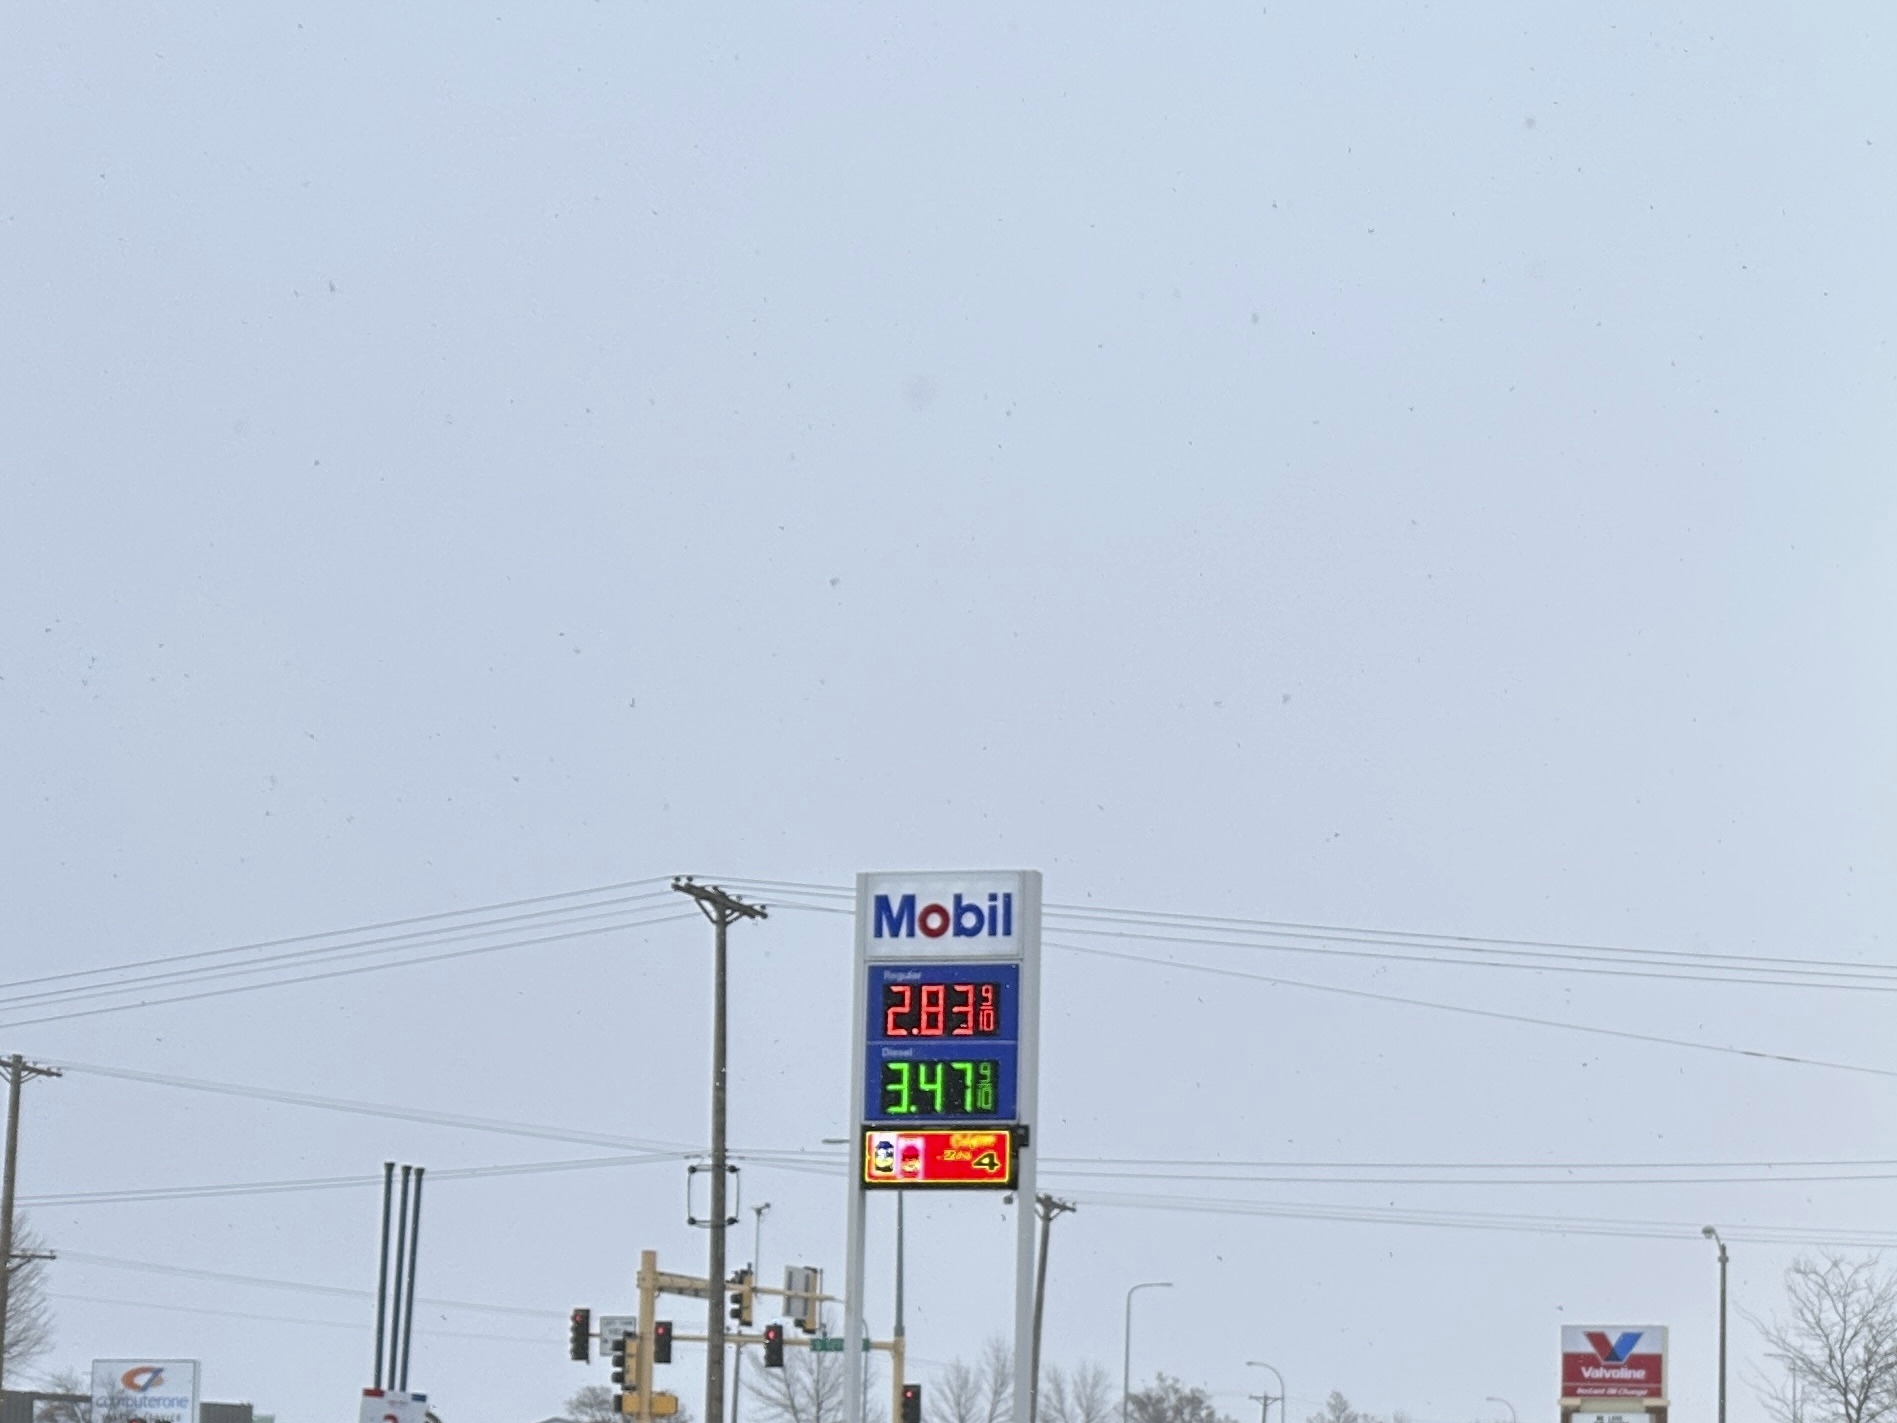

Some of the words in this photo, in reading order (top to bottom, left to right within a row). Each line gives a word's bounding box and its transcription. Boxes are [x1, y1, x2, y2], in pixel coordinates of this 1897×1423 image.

[873, 892, 1013, 939] Mobil
[886, 985, 975, 1036] 2.83
[885, 1062, 973, 1114] 3.47
[1581, 1366, 1646, 1380] Valvoline
